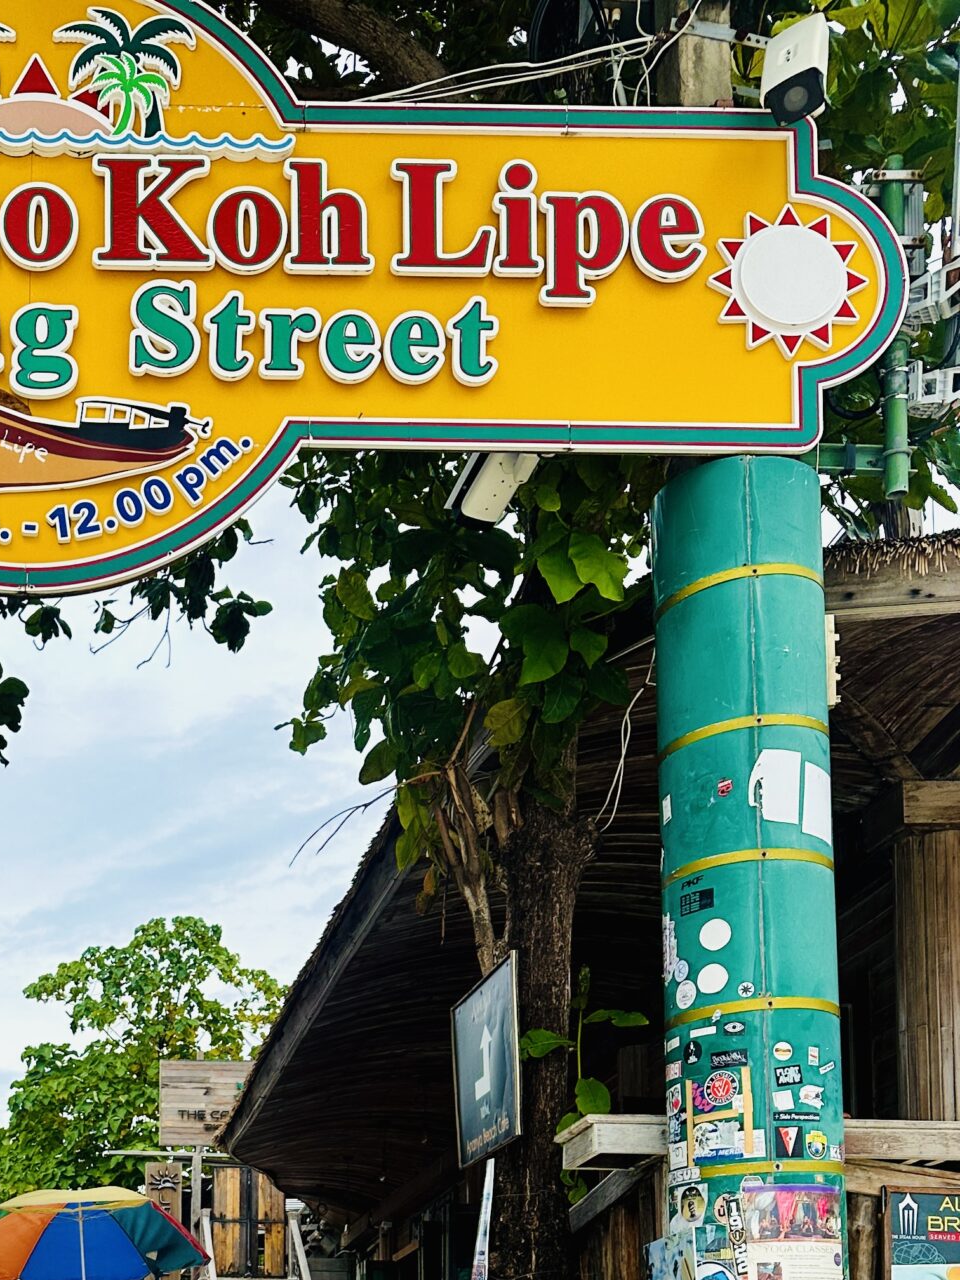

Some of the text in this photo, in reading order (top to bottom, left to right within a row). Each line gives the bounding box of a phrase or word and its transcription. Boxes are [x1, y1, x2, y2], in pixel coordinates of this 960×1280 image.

[93, 153, 374, 275] Koh
[391, 158, 707, 308] Lipe
[130, 279, 500, 387] Street
[0, 429, 50, 464] Lipe
[46, 475, 175, 544] 12.00
[173, 436, 254, 508] pm.
